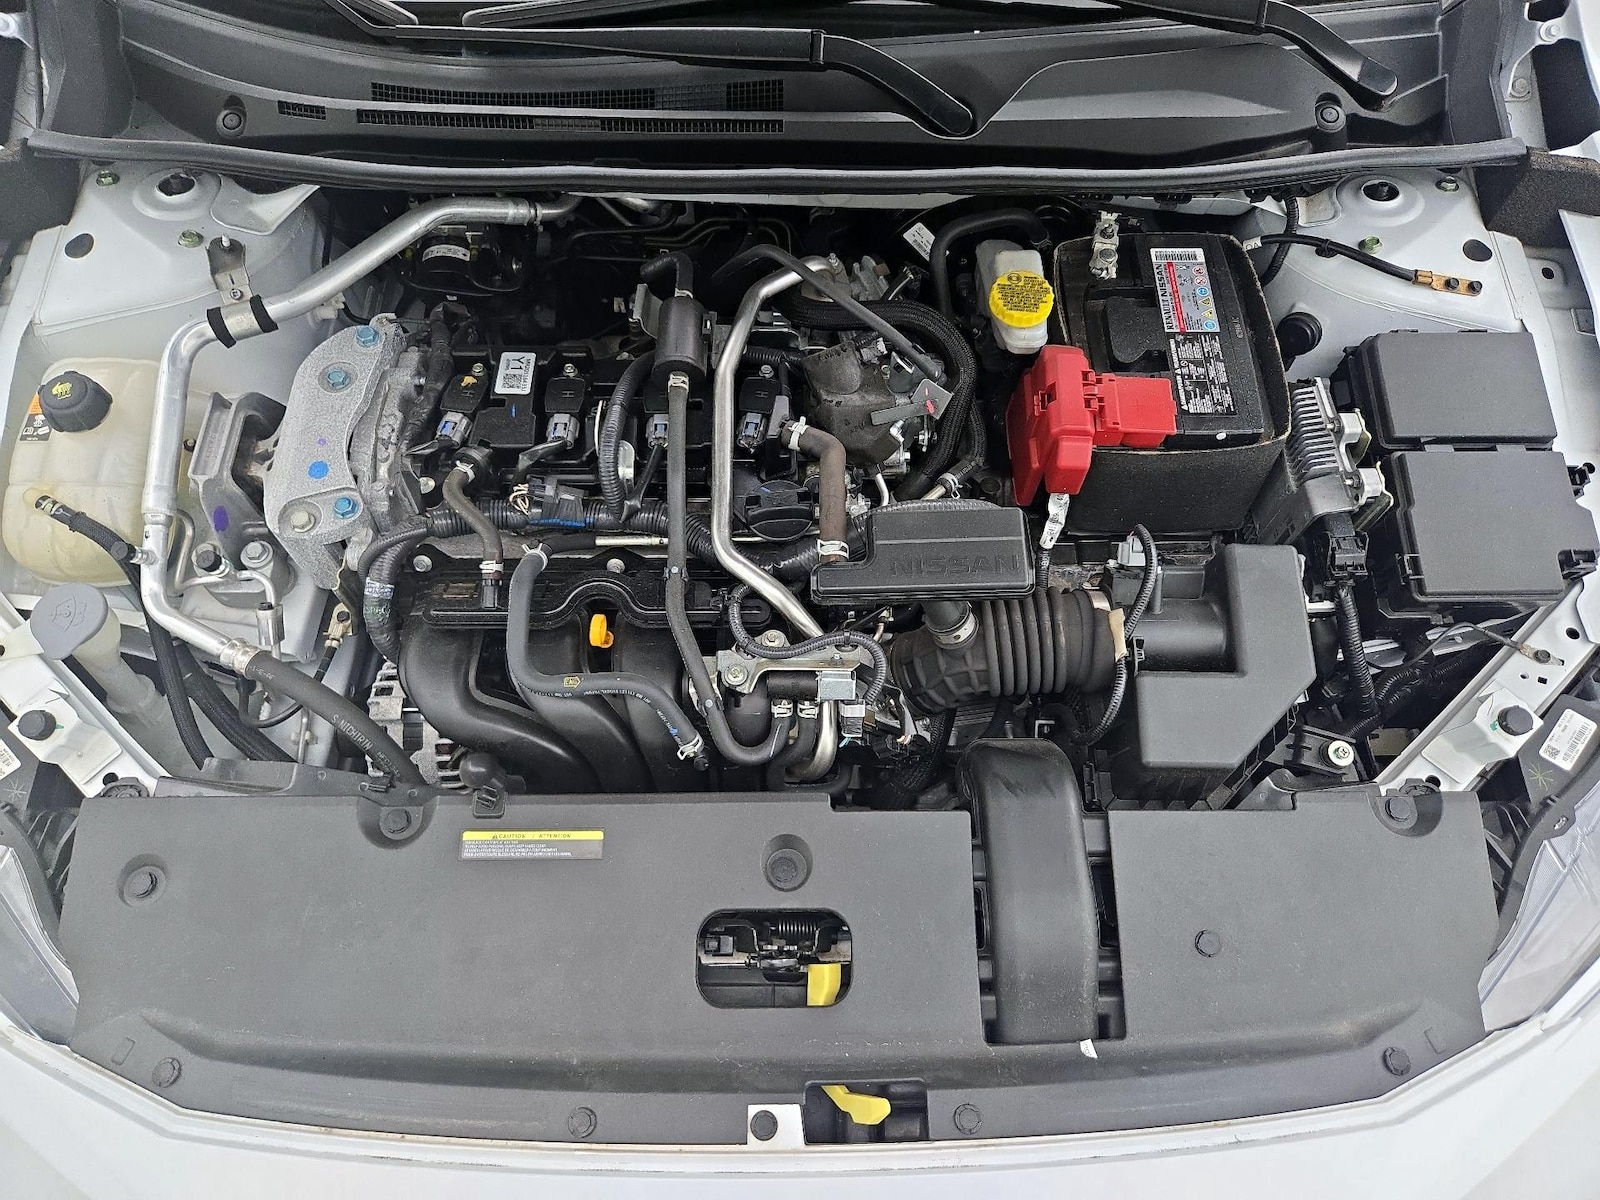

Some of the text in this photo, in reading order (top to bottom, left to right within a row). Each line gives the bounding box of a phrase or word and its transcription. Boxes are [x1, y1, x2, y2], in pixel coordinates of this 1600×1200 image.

[1154, 263, 1168, 297] NISSAN
[1160, 299, 1175, 331] RENAULT
[511, 356, 525, 370] Y1
[889, 554, 1020, 576] NISSAN
[339, 719, 373, 751] NICHIRIN
